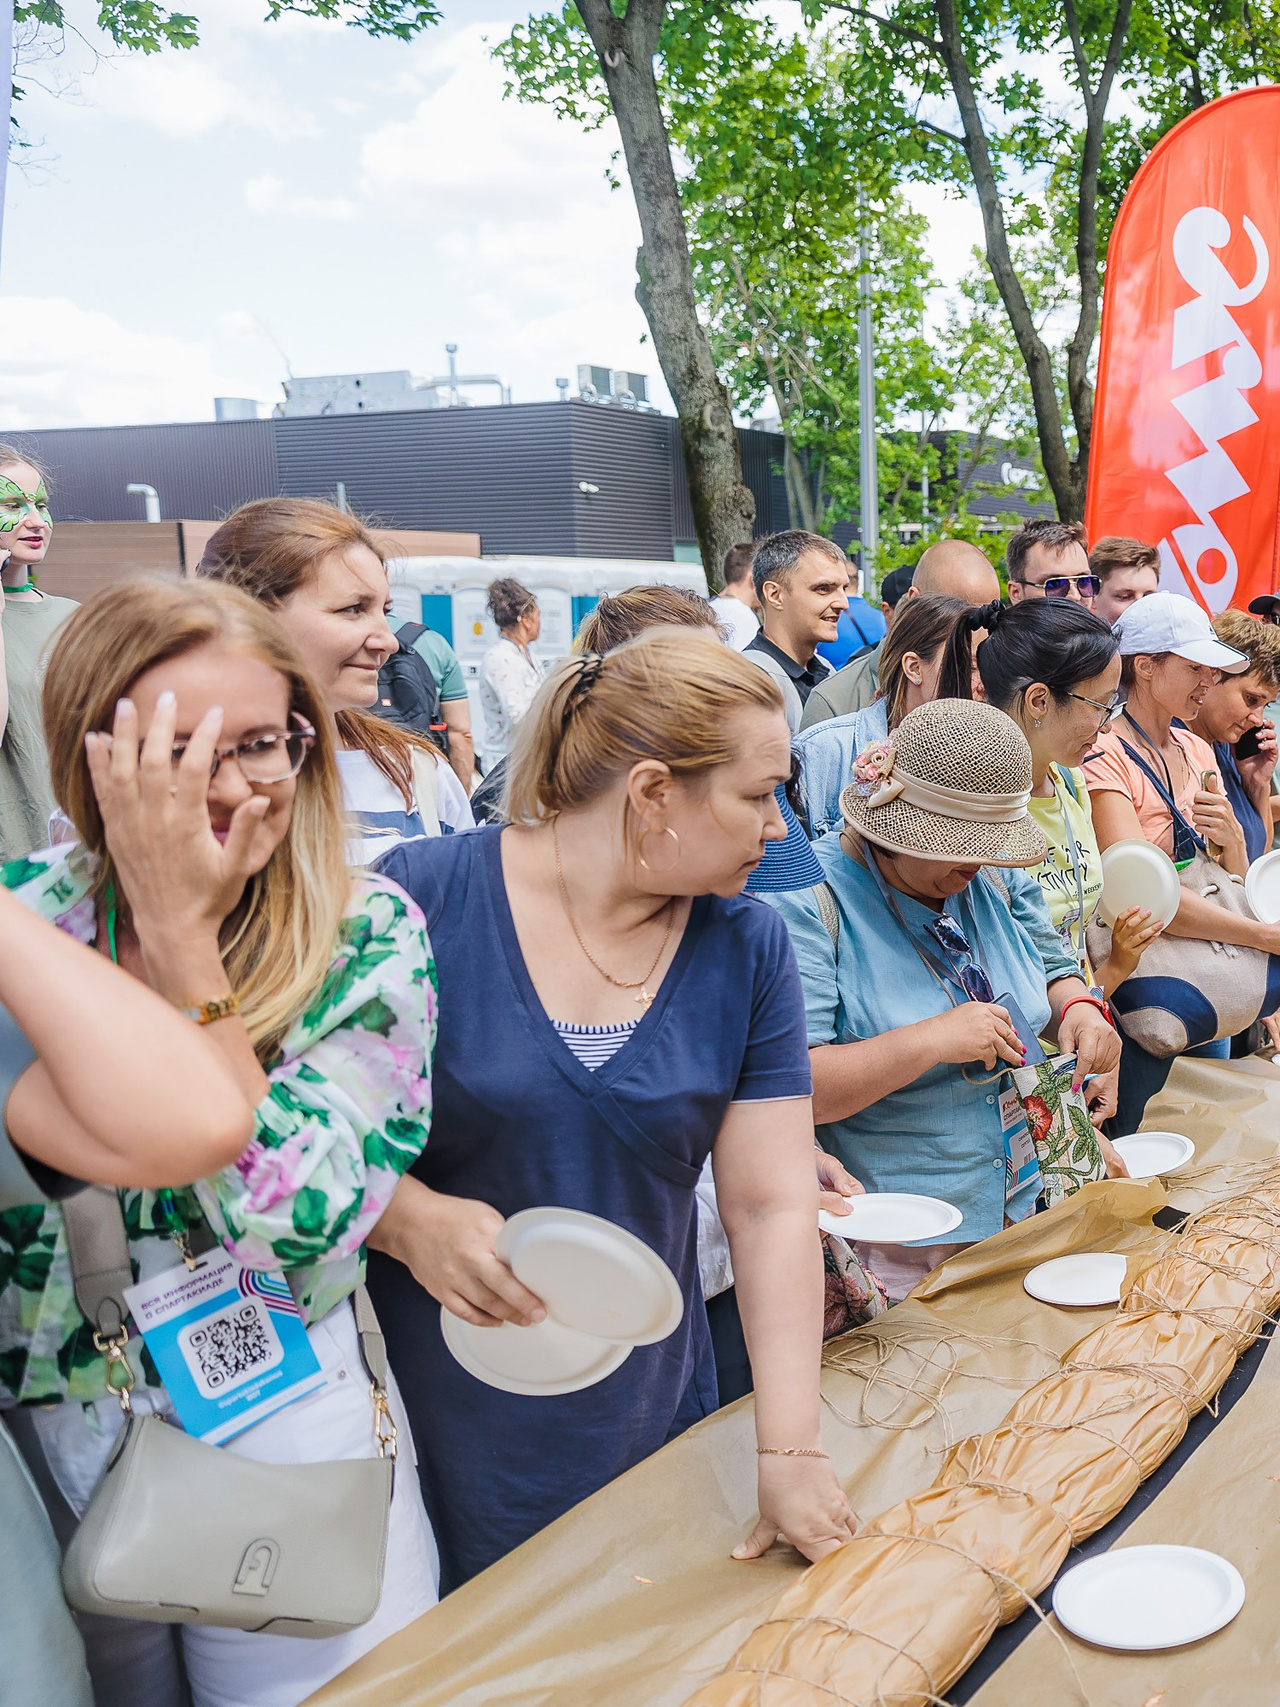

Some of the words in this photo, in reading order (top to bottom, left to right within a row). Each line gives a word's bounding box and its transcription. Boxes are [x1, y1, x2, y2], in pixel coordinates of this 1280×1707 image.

[1157, 206, 1270, 616] омус
[141, 1296, 160, 1310] ВСЯ
[163, 1261, 234, 1299] ИНФОРМАЦИЯ
[145, 1311, 153, 1320] О
[155, 1277, 224, 1315] СПАРТАКИАДЕ
